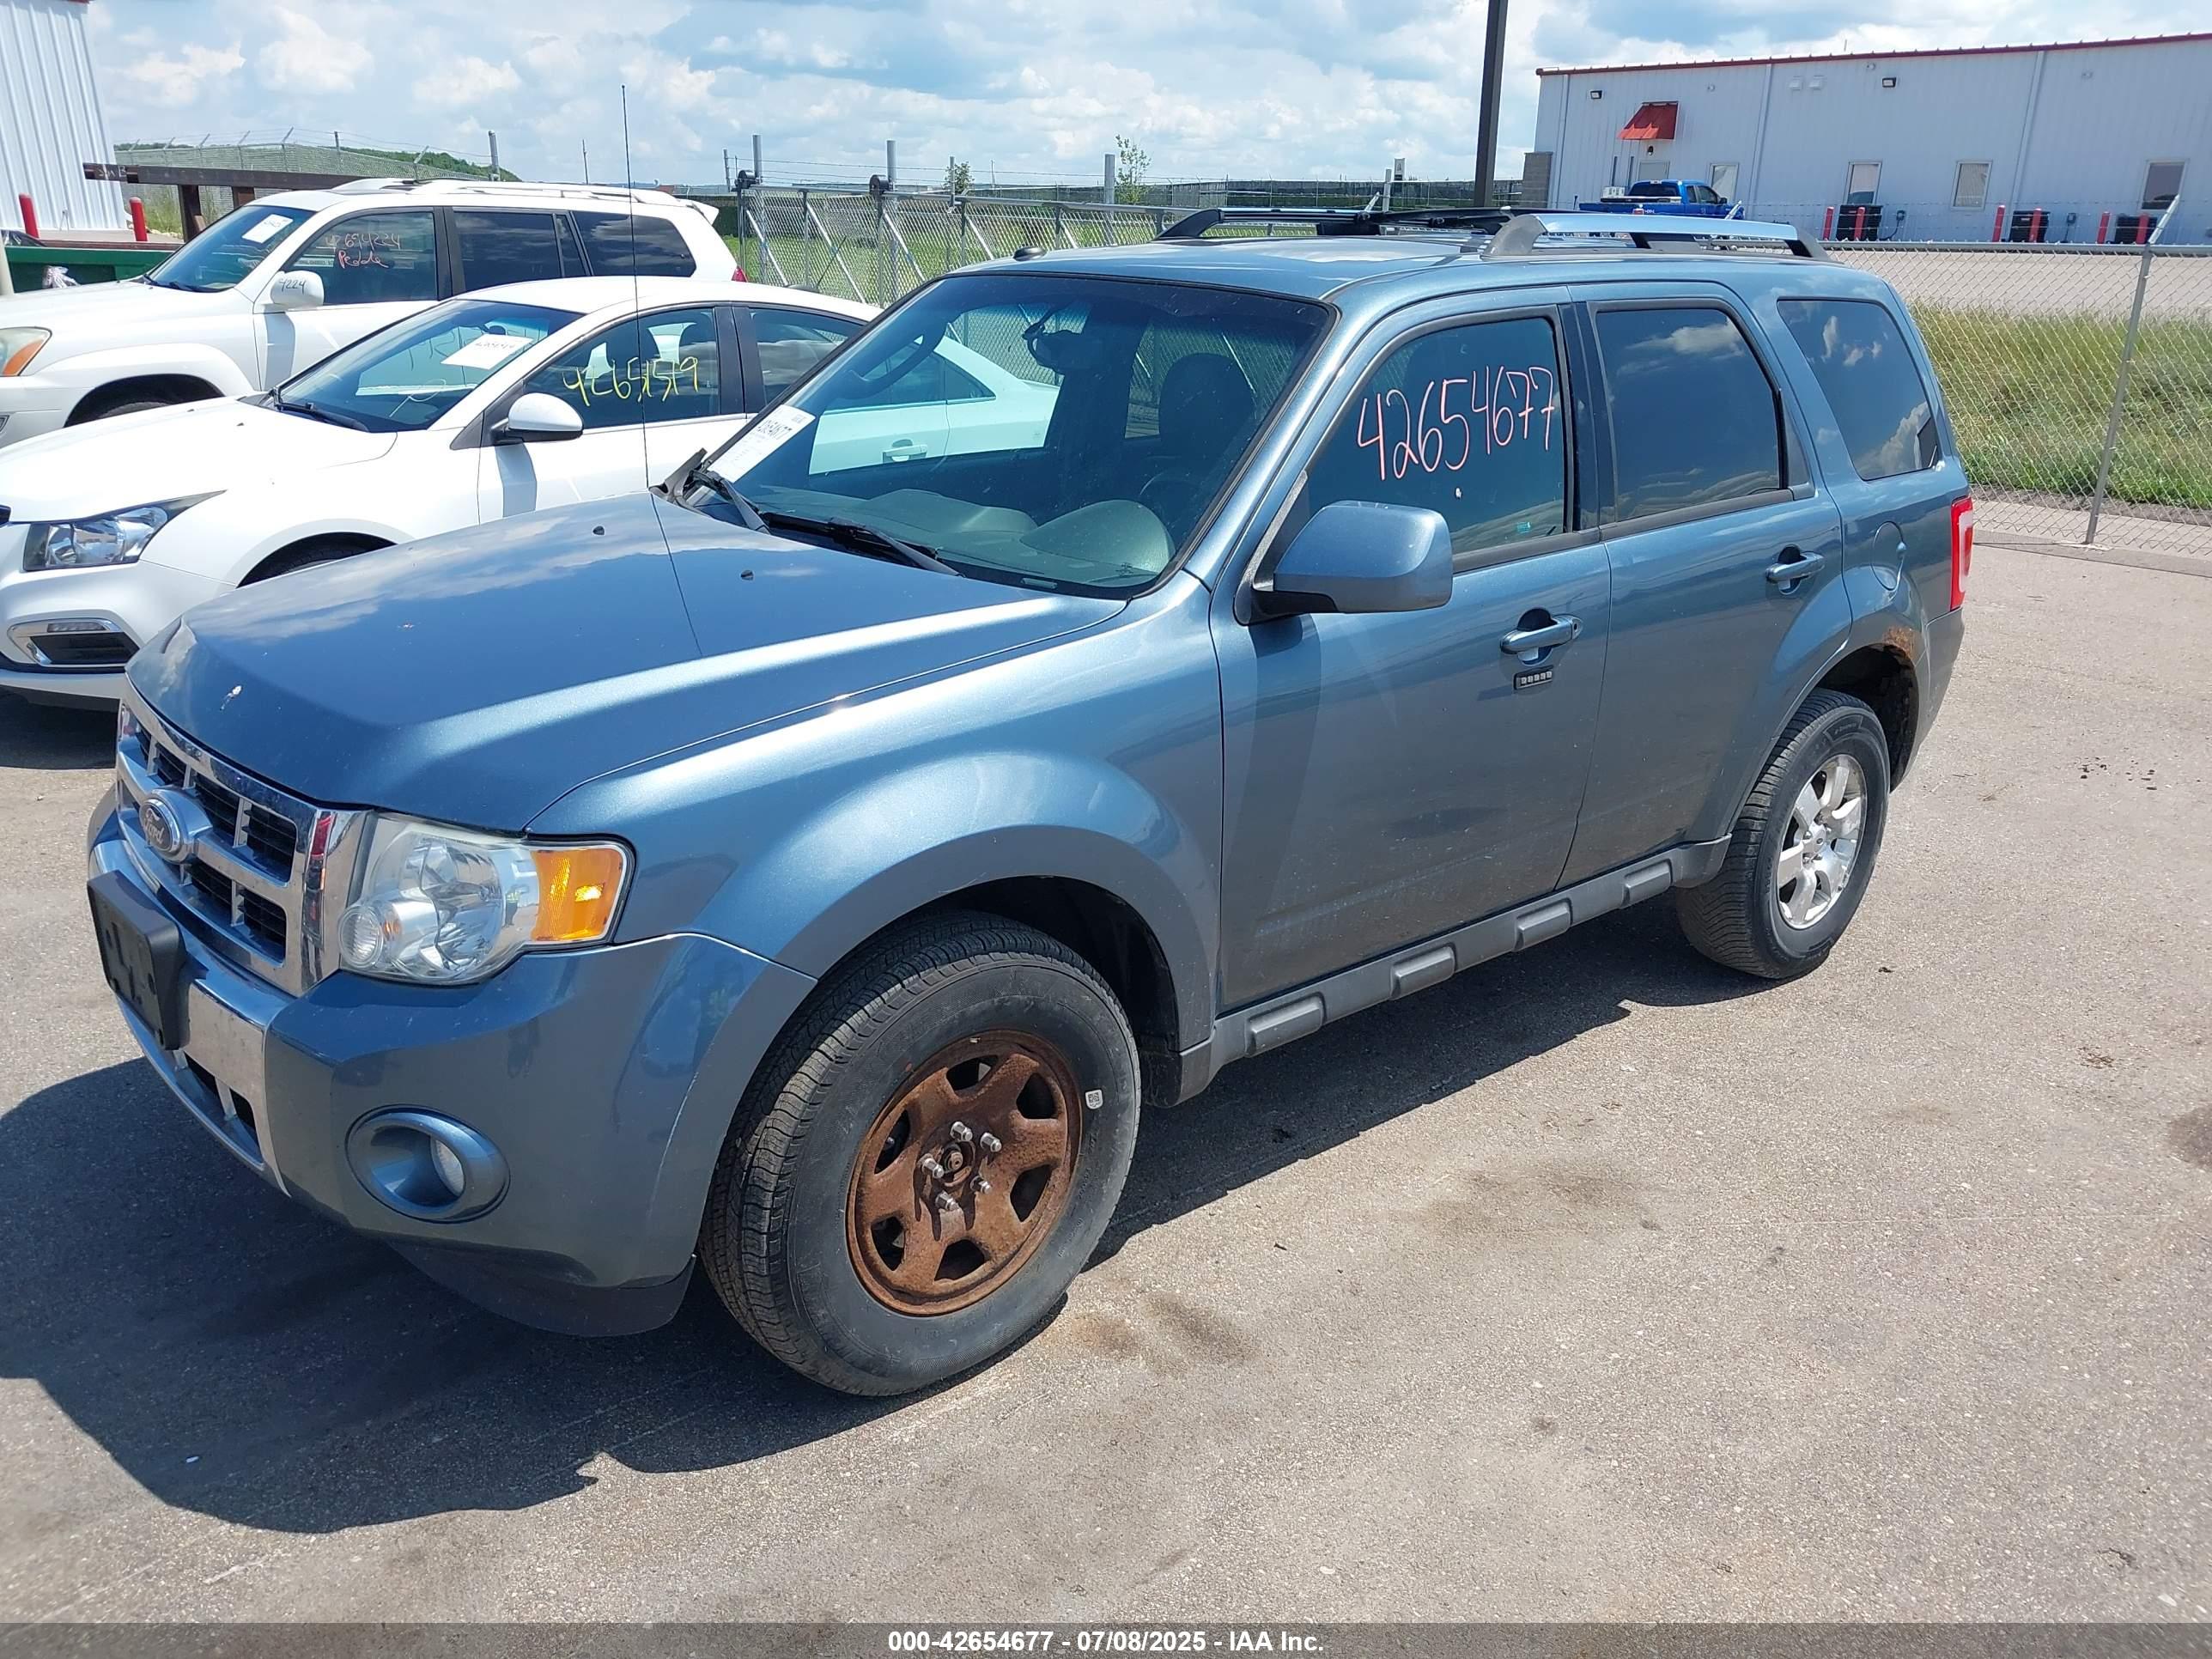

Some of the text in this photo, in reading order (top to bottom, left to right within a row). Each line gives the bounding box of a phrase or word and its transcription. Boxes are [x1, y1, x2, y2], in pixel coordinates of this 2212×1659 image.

[279, 278, 307, 295] 4224
[1357, 365, 1555, 481] 42654677
[143, 808, 165, 844] Ford
